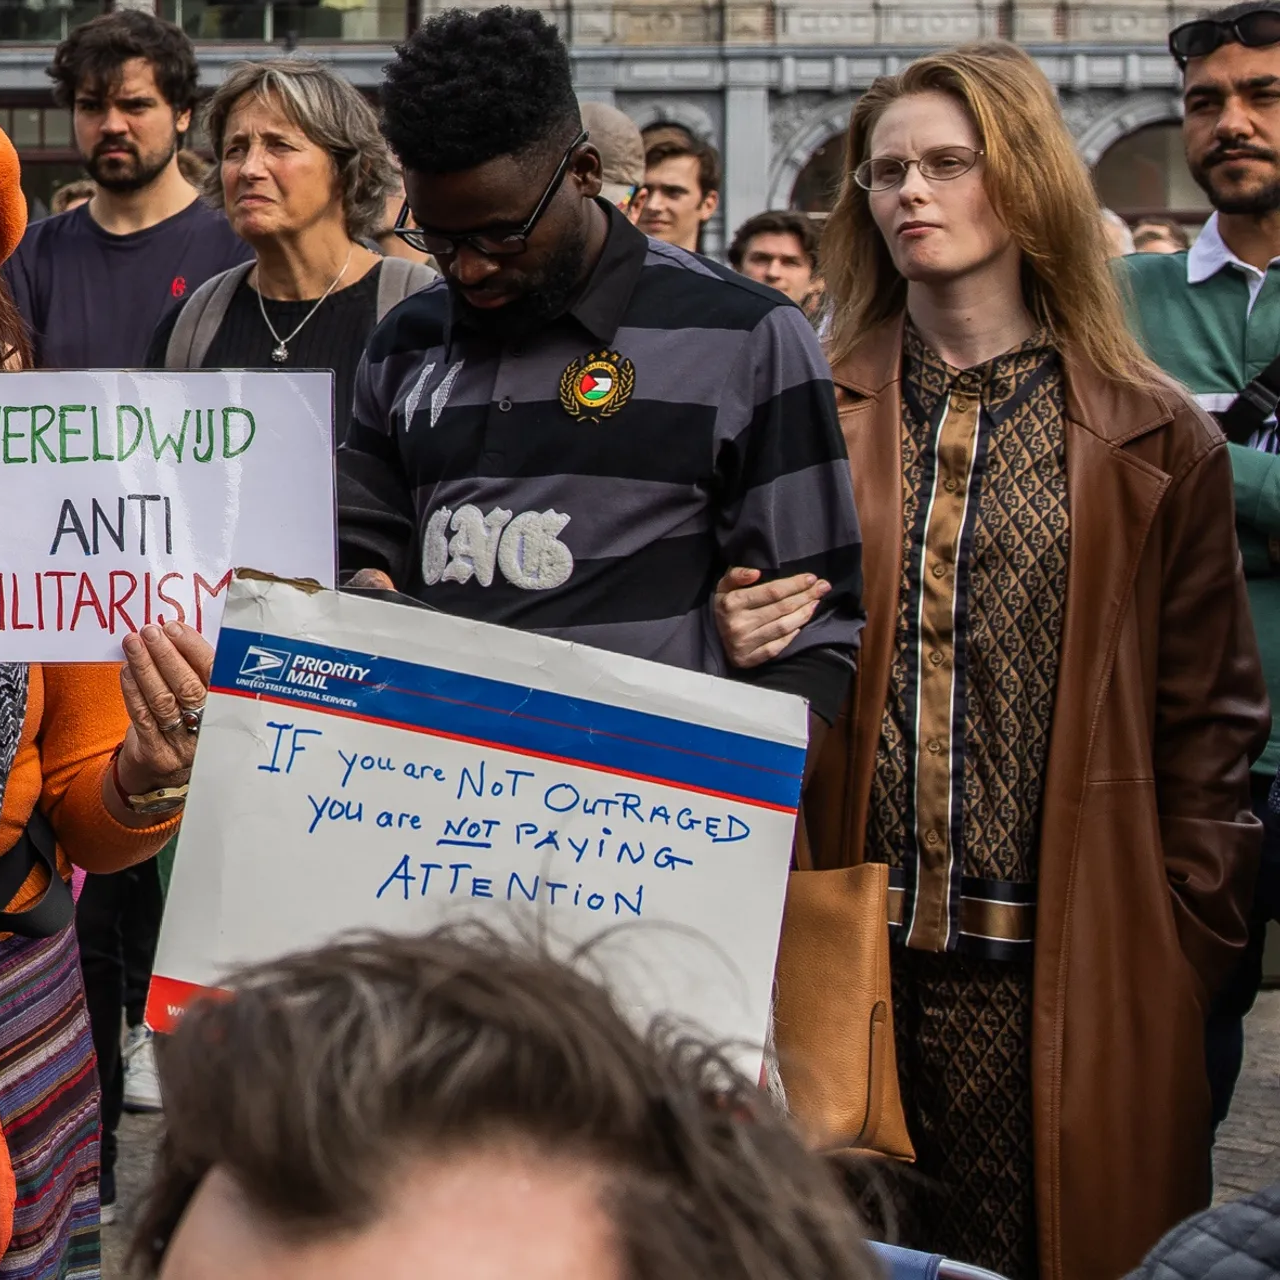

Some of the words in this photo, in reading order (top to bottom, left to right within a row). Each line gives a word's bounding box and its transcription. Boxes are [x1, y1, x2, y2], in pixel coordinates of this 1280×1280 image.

[49, 494, 173, 556] ANTI
[285, 669, 328, 690] MAIL
[292, 654, 371, 682] PRIORITY
[235, 678, 265, 689] UNITED
[265, 683, 291, 695] STATES
[292, 688, 320, 700] POSTAL
[257, 721, 322, 773] IF
[338, 750, 396, 787] you
[402, 762, 446, 782] are
[376, 806, 422, 830] are
[442, 818, 500, 841] NOT
